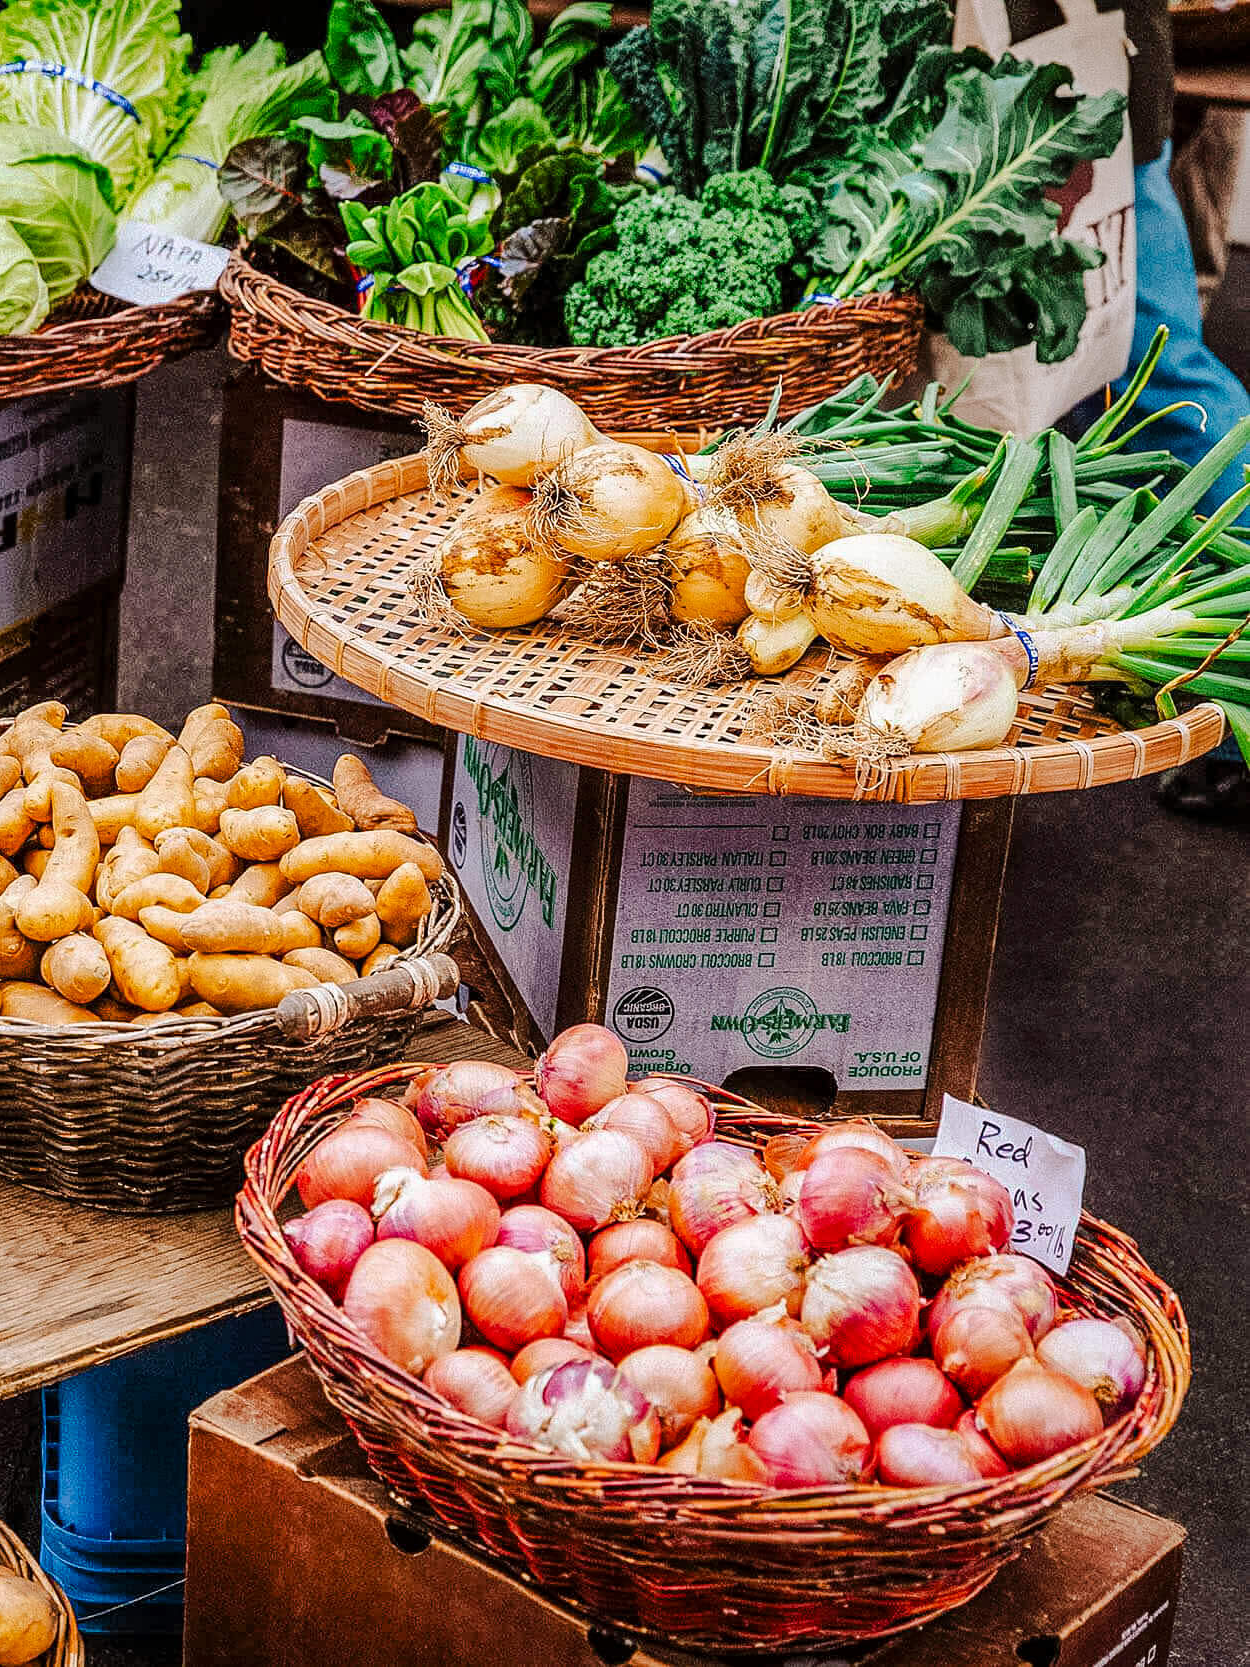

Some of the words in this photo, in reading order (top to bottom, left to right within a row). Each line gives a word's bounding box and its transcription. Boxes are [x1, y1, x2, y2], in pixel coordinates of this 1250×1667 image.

[830, 824, 861, 840] CHOY
[863, 823, 887, 840] BOK
[889, 822, 920, 840] BABY
[670, 850, 718, 867] PARSLEY
[721, 850, 765, 867] ITALIAN
[840, 849, 877, 865] BEANS
[880, 848, 917, 865] GREEN
[677, 877, 725, 893] PARSLEY
[728, 877, 762, 892] CURLY
[860, 874, 913, 890] RADISHES
[674, 903, 690, 918] CT
[703, 902, 759, 918] CILANTRO
[813, 902, 828, 916] LB
[842, 901, 879, 916] BEANS
[882, 900, 910, 915] FAVA
[630, 930, 645, 944] LB
[659, 928, 712, 943] BROCCOLI
[715, 928, 757, 943] PURPLE
[800, 928, 814, 941] LB
[815, 927, 829, 941] 25
[830, 927, 858, 941] PEAS
[861, 926, 907, 940] ENGLISH
[620, 954, 635, 969] LB
[648, 953, 698, 969] CROWNS
[700, 953, 754, 968] BROCCOLI
[850, 950, 903, 967] BROCCOLI
[622, 1001, 667, 1014] ORGANIC
[625, 1016, 660, 1029] USDA
[628, 1048, 676, 1060] Grown
[853, 1051, 897, 1064] U.S.A.
[899, 1051, 921, 1063] OF
[627, 1061, 692, 1075] Organica
[847, 1064, 923, 1078] PRODUCE
[976, 1120, 1033, 1168] Red
